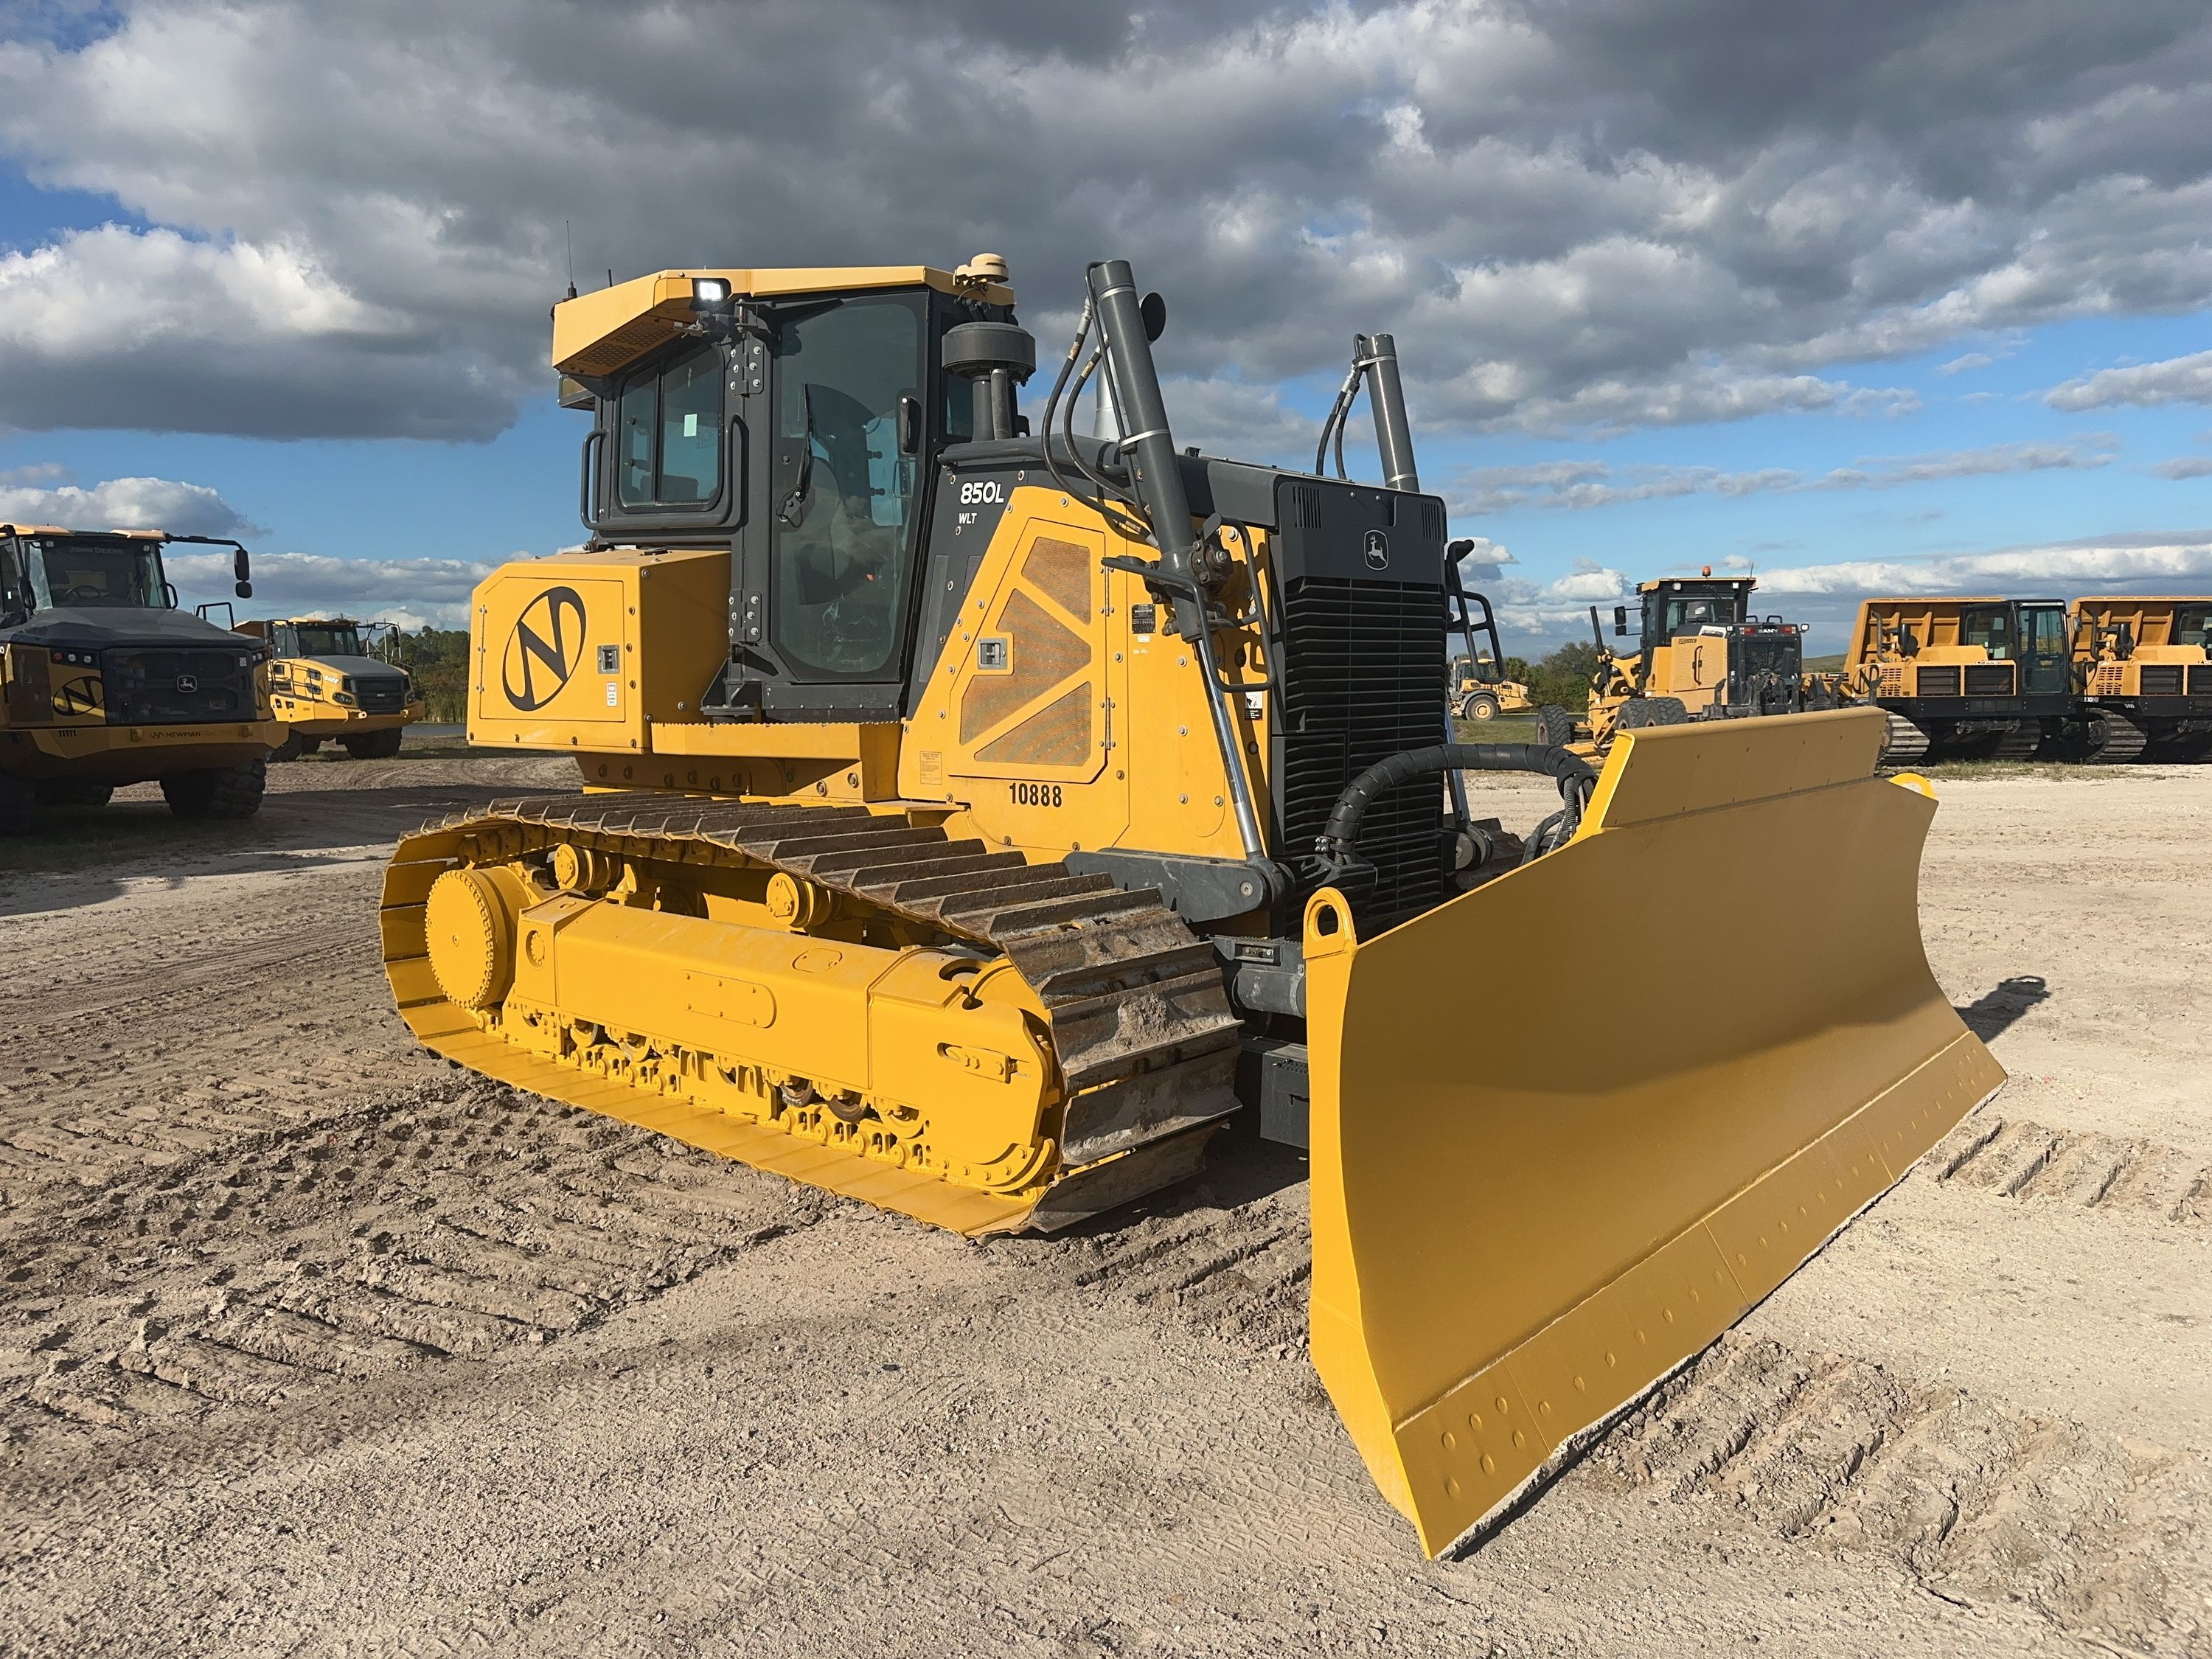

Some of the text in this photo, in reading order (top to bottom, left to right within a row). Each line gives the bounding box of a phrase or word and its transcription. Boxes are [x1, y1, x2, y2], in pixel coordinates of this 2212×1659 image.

[960, 481, 1004, 504] 850L
[959, 512, 978, 524] WLT
[1009, 782, 1062, 808] 10888
